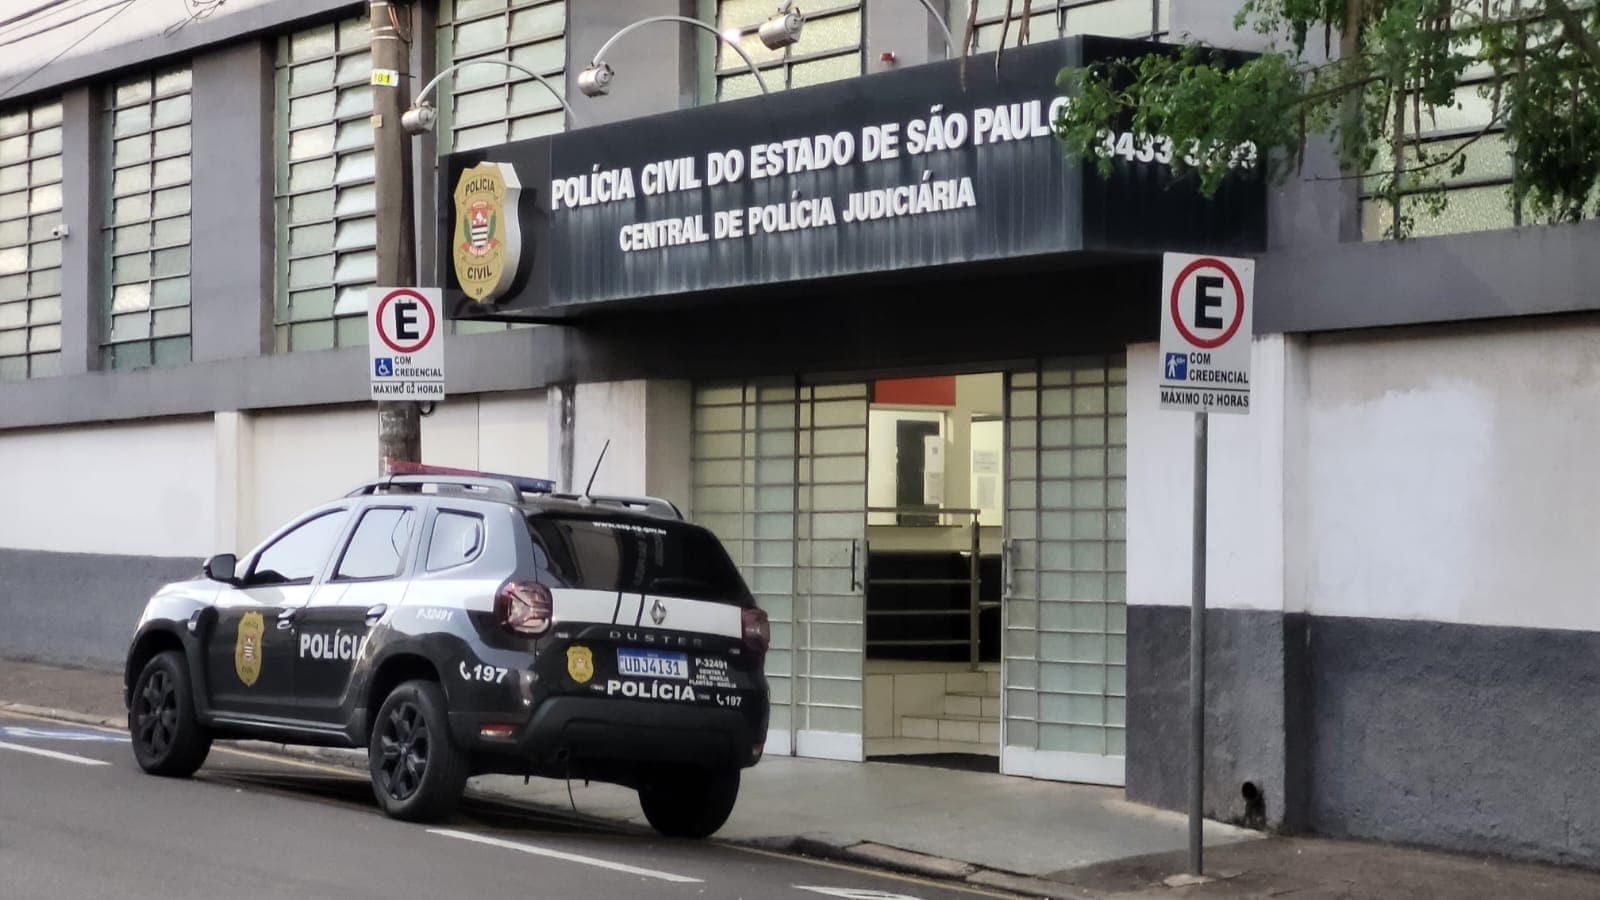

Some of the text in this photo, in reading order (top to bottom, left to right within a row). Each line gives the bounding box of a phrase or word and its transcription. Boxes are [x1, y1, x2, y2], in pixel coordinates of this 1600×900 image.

[551, 165, 636, 210] POLÍCIA
[641, 156, 702, 196] CIVIL
[707, 149, 744, 186] DO
[750, 131, 855, 179] ESTADO
[862, 122, 899, 162] DE
[906, 104, 968, 155] SÃO
[620, 170, 977, 252] CENTRAL DE POLÍCIA JUDICIÁRIA
[467, 265, 493, 280] CIVIL
[1194, 275, 1224, 330] E
[395, 302, 419, 340] E
[394, 356, 412, 365] COM
[1189, 352, 1211, 365] COM
[395, 368, 442, 377] CREDENCIAL
[1189, 369, 1249, 384] CREDENCIAL
[417, 385, 444, 394] HORAS
[1202, 393, 1214, 406] 02
[1216, 394, 1249, 407] HORAS
[300, 628, 367, 661] POLÍCIA
[473, 664, 508, 684] 197
[624, 657, 681, 676] UDJ4131
[607, 680, 696, 701] POLÍCIA
